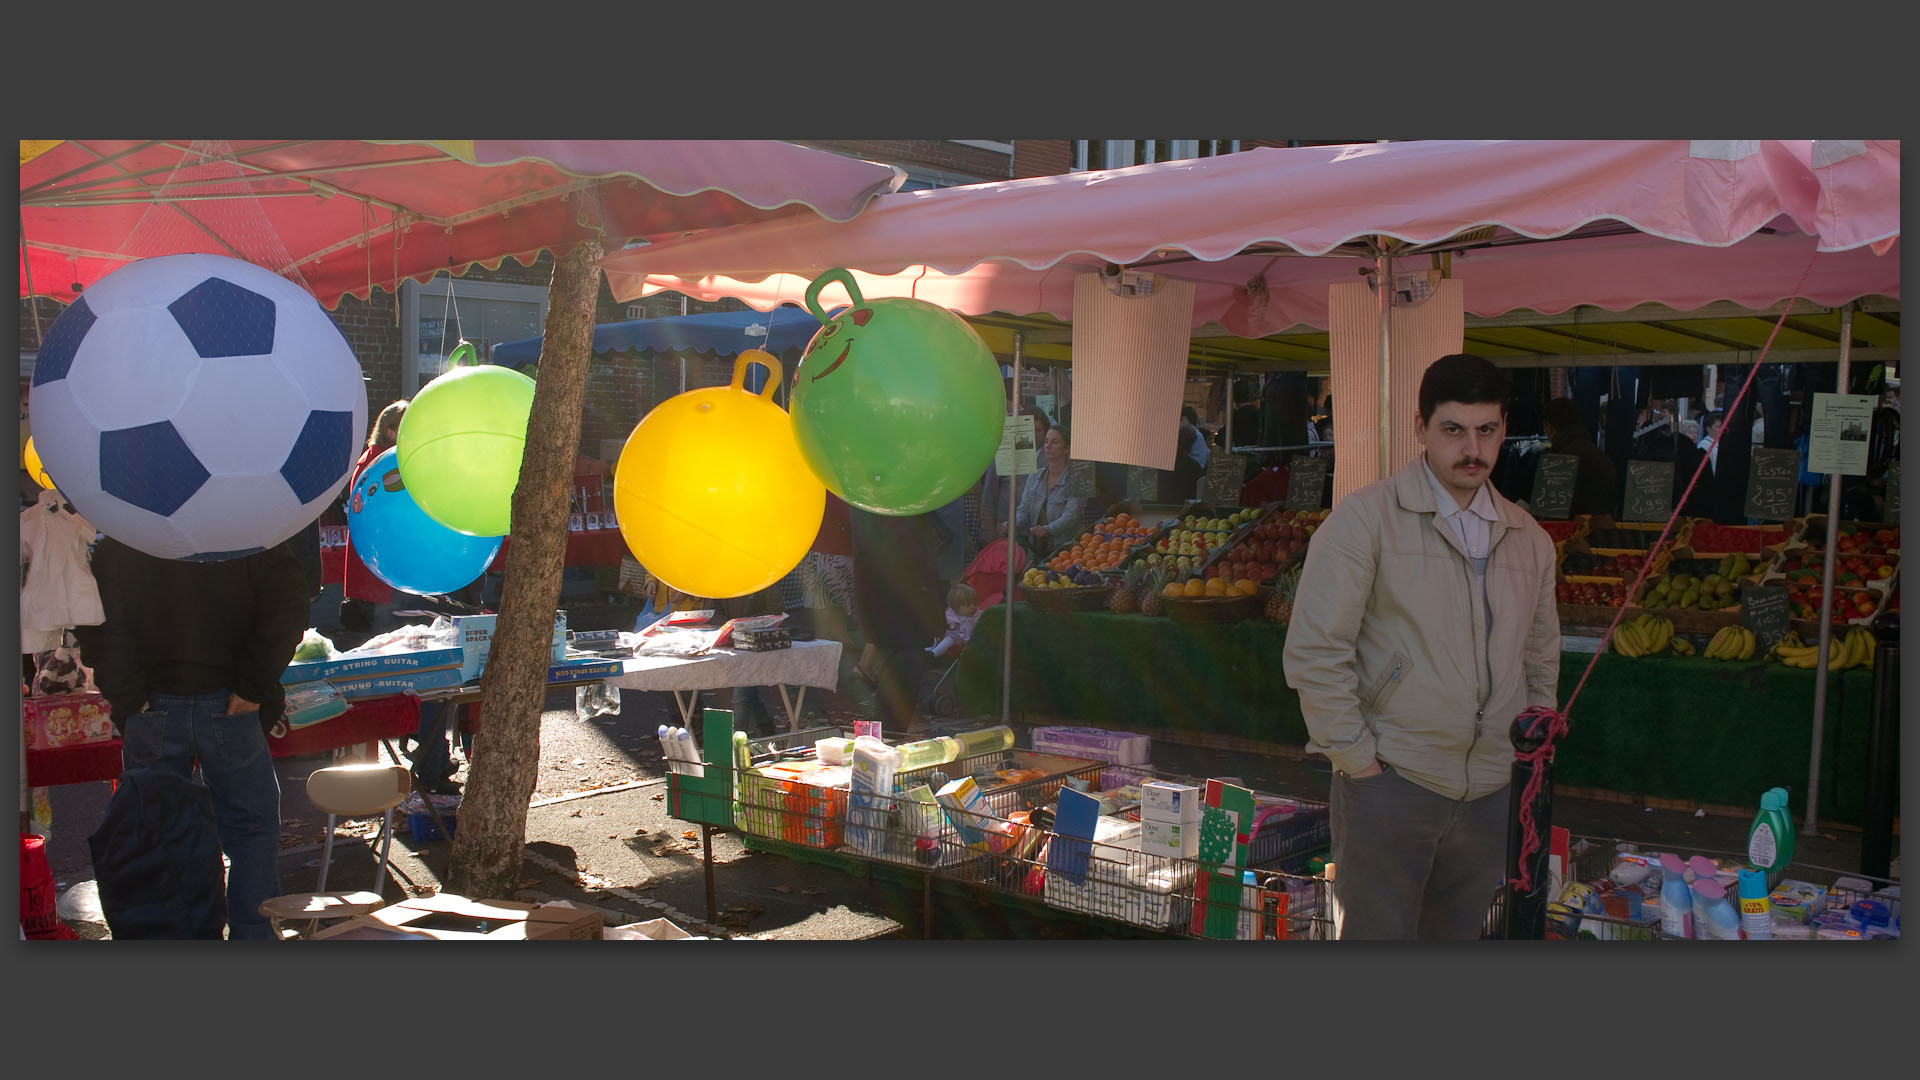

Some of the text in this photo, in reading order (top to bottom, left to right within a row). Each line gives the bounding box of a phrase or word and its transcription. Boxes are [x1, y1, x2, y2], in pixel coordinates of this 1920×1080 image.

[342, 660, 378, 671] STRING
[384, 658, 419, 667] GUITAR
[378, 680, 415, 688] GUITAR
[1145, 789, 1161, 798] Dove
[1144, 823, 1160, 831] Dove
